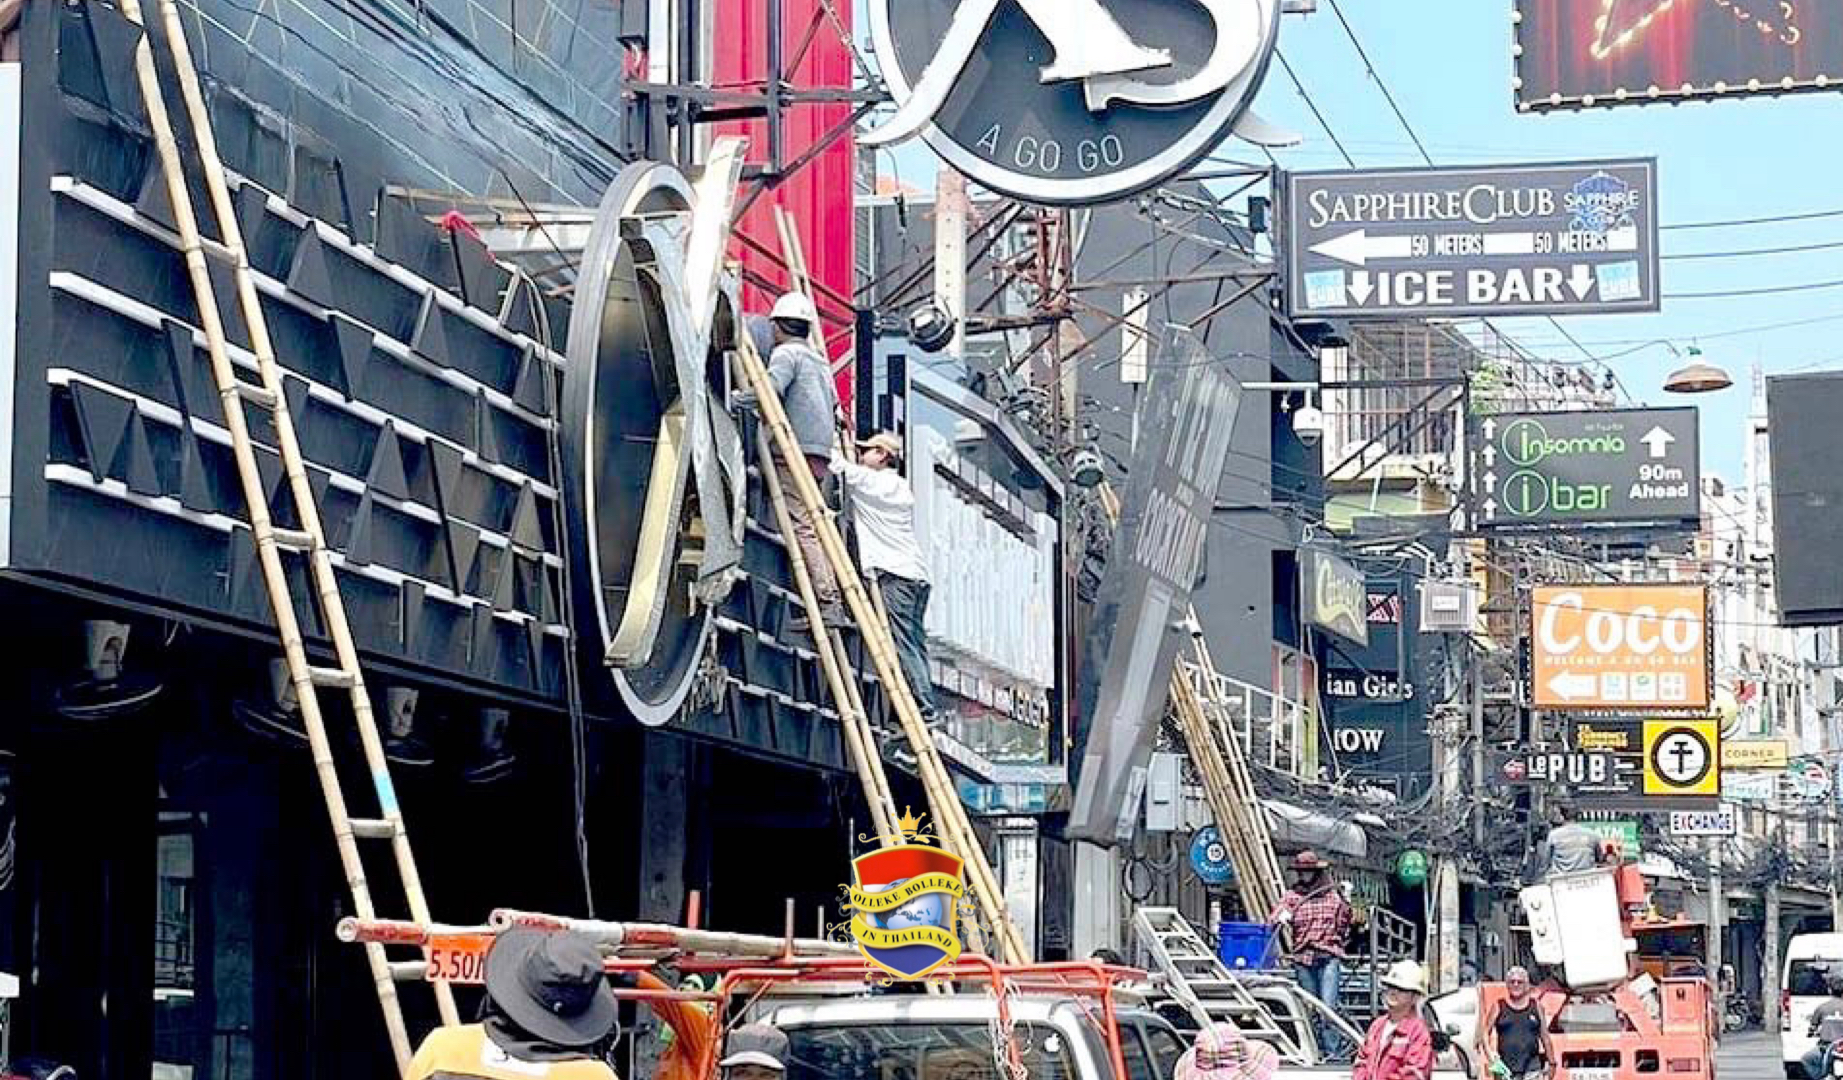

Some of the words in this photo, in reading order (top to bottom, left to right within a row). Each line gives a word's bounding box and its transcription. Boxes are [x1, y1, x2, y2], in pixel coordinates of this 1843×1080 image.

[976, 124, 1000, 156] A
[1014, 136, 1061, 172] GO
[1077, 134, 1123, 172] GO
[1411, 233, 1429, 257] 50
[1433, 233, 1484, 256] METERS
[1534, 231, 1552, 254] 50
[1557, 231, 1608, 253] METERS
[1377, 270, 1454, 306] ICE
[1467, 267, 1565, 304] BAR
[1638, 464, 1684, 481] 90m
[1551, 476, 1612, 511] bar
[1629, 483, 1689, 499] Ahead
[1724, 750, 1775, 759] CORNER
[1549, 753, 1606, 783] PUB
[1673, 813, 1731, 831] EXCHANGE
